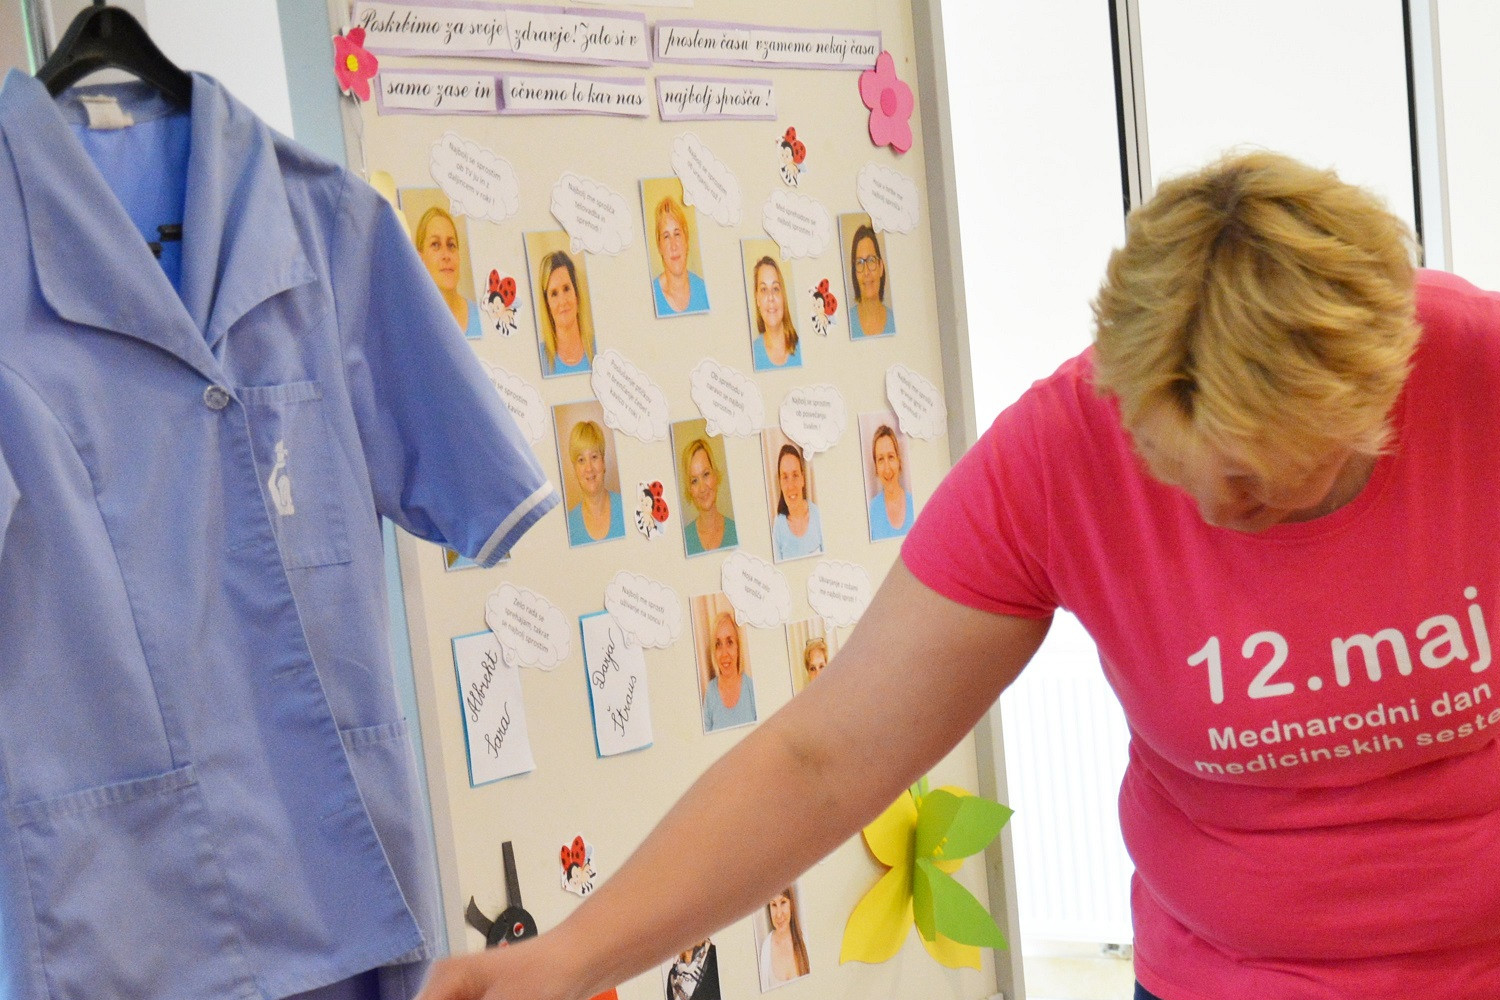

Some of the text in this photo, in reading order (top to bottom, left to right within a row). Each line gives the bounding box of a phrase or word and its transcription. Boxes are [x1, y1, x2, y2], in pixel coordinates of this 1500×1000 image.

[357, 9, 440, 34] Poskrbimo
[445, 20, 464, 44] za
[469, 16, 503, 46] svoje
[513, 20, 578, 51] zdravje!
[614, 29, 625, 47] si
[630, 34, 639, 47] v
[664, 28, 875, 62] prostem času vzamemo nekaj časa
[386, 80, 492, 107] samo zase in
[511, 82, 644, 106] očnemo to kar nas
[664, 84, 713, 113] najbolj
[715, 87, 761, 114] sprošča
[449, 142, 502, 181] Najbolj se sprostim
[513, 597, 545, 623] Zelo rada se
[621, 586, 640, 603] Najbolj
[640, 596, 648, 606] me
[501, 619, 549, 654] se najbolj sprostim
[1207, 682, 1493, 751] Mednarodni dan
[1194, 732, 1405, 775] medicinskih
